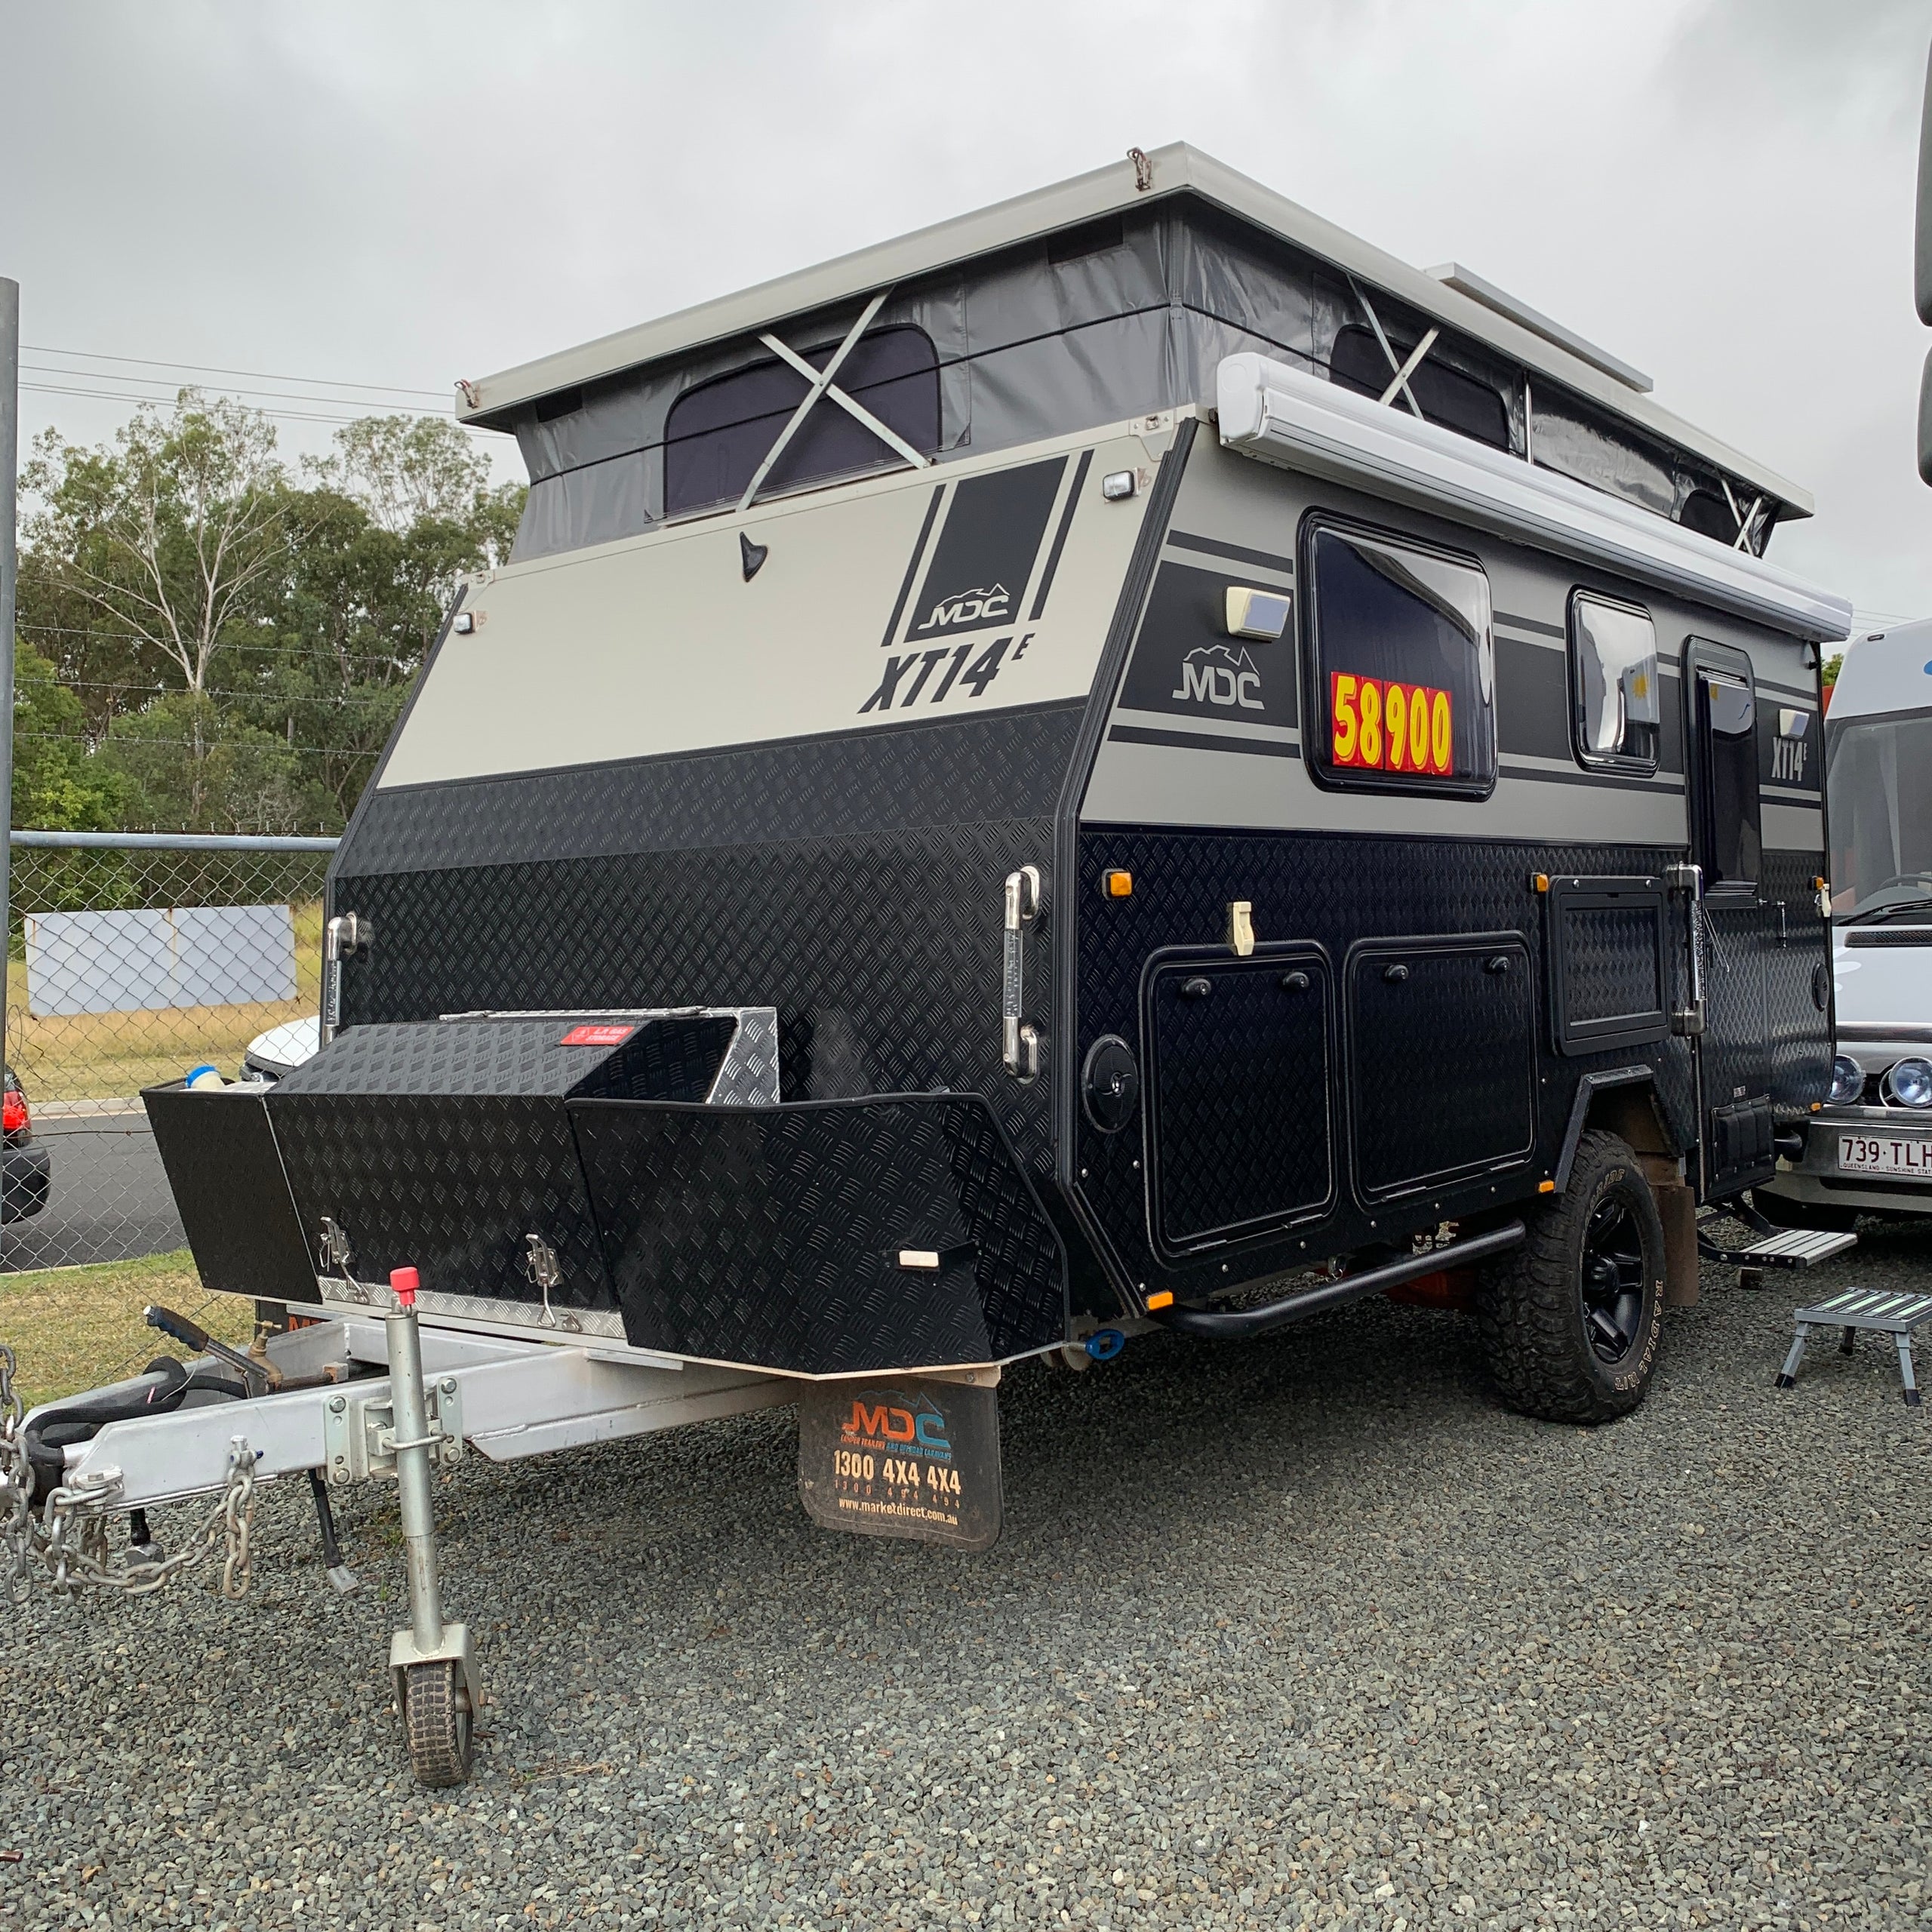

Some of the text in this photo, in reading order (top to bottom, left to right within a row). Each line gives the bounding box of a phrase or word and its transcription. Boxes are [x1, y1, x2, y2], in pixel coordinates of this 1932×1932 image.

[918, 595, 1010, 630] MDC
[1172, 663, 1266, 710] MDC
[1334, 675, 1452, 773] 58900
[1843, 1162, 1880, 1171] QUEENSLAND
[1638, 1279, 1664, 1375] RADIAL
[841, 1401, 951, 1449] MDC
[833, 1449, 961, 1495] 1300 4X4 4X4
[861, 1438, 886, 1451] TRAILERS
[886, 1441, 900, 1451] AND
[924, 1448, 952, 1460] CARAVANS
[838, 1497, 958, 1526] www.marketdirect.com.au
